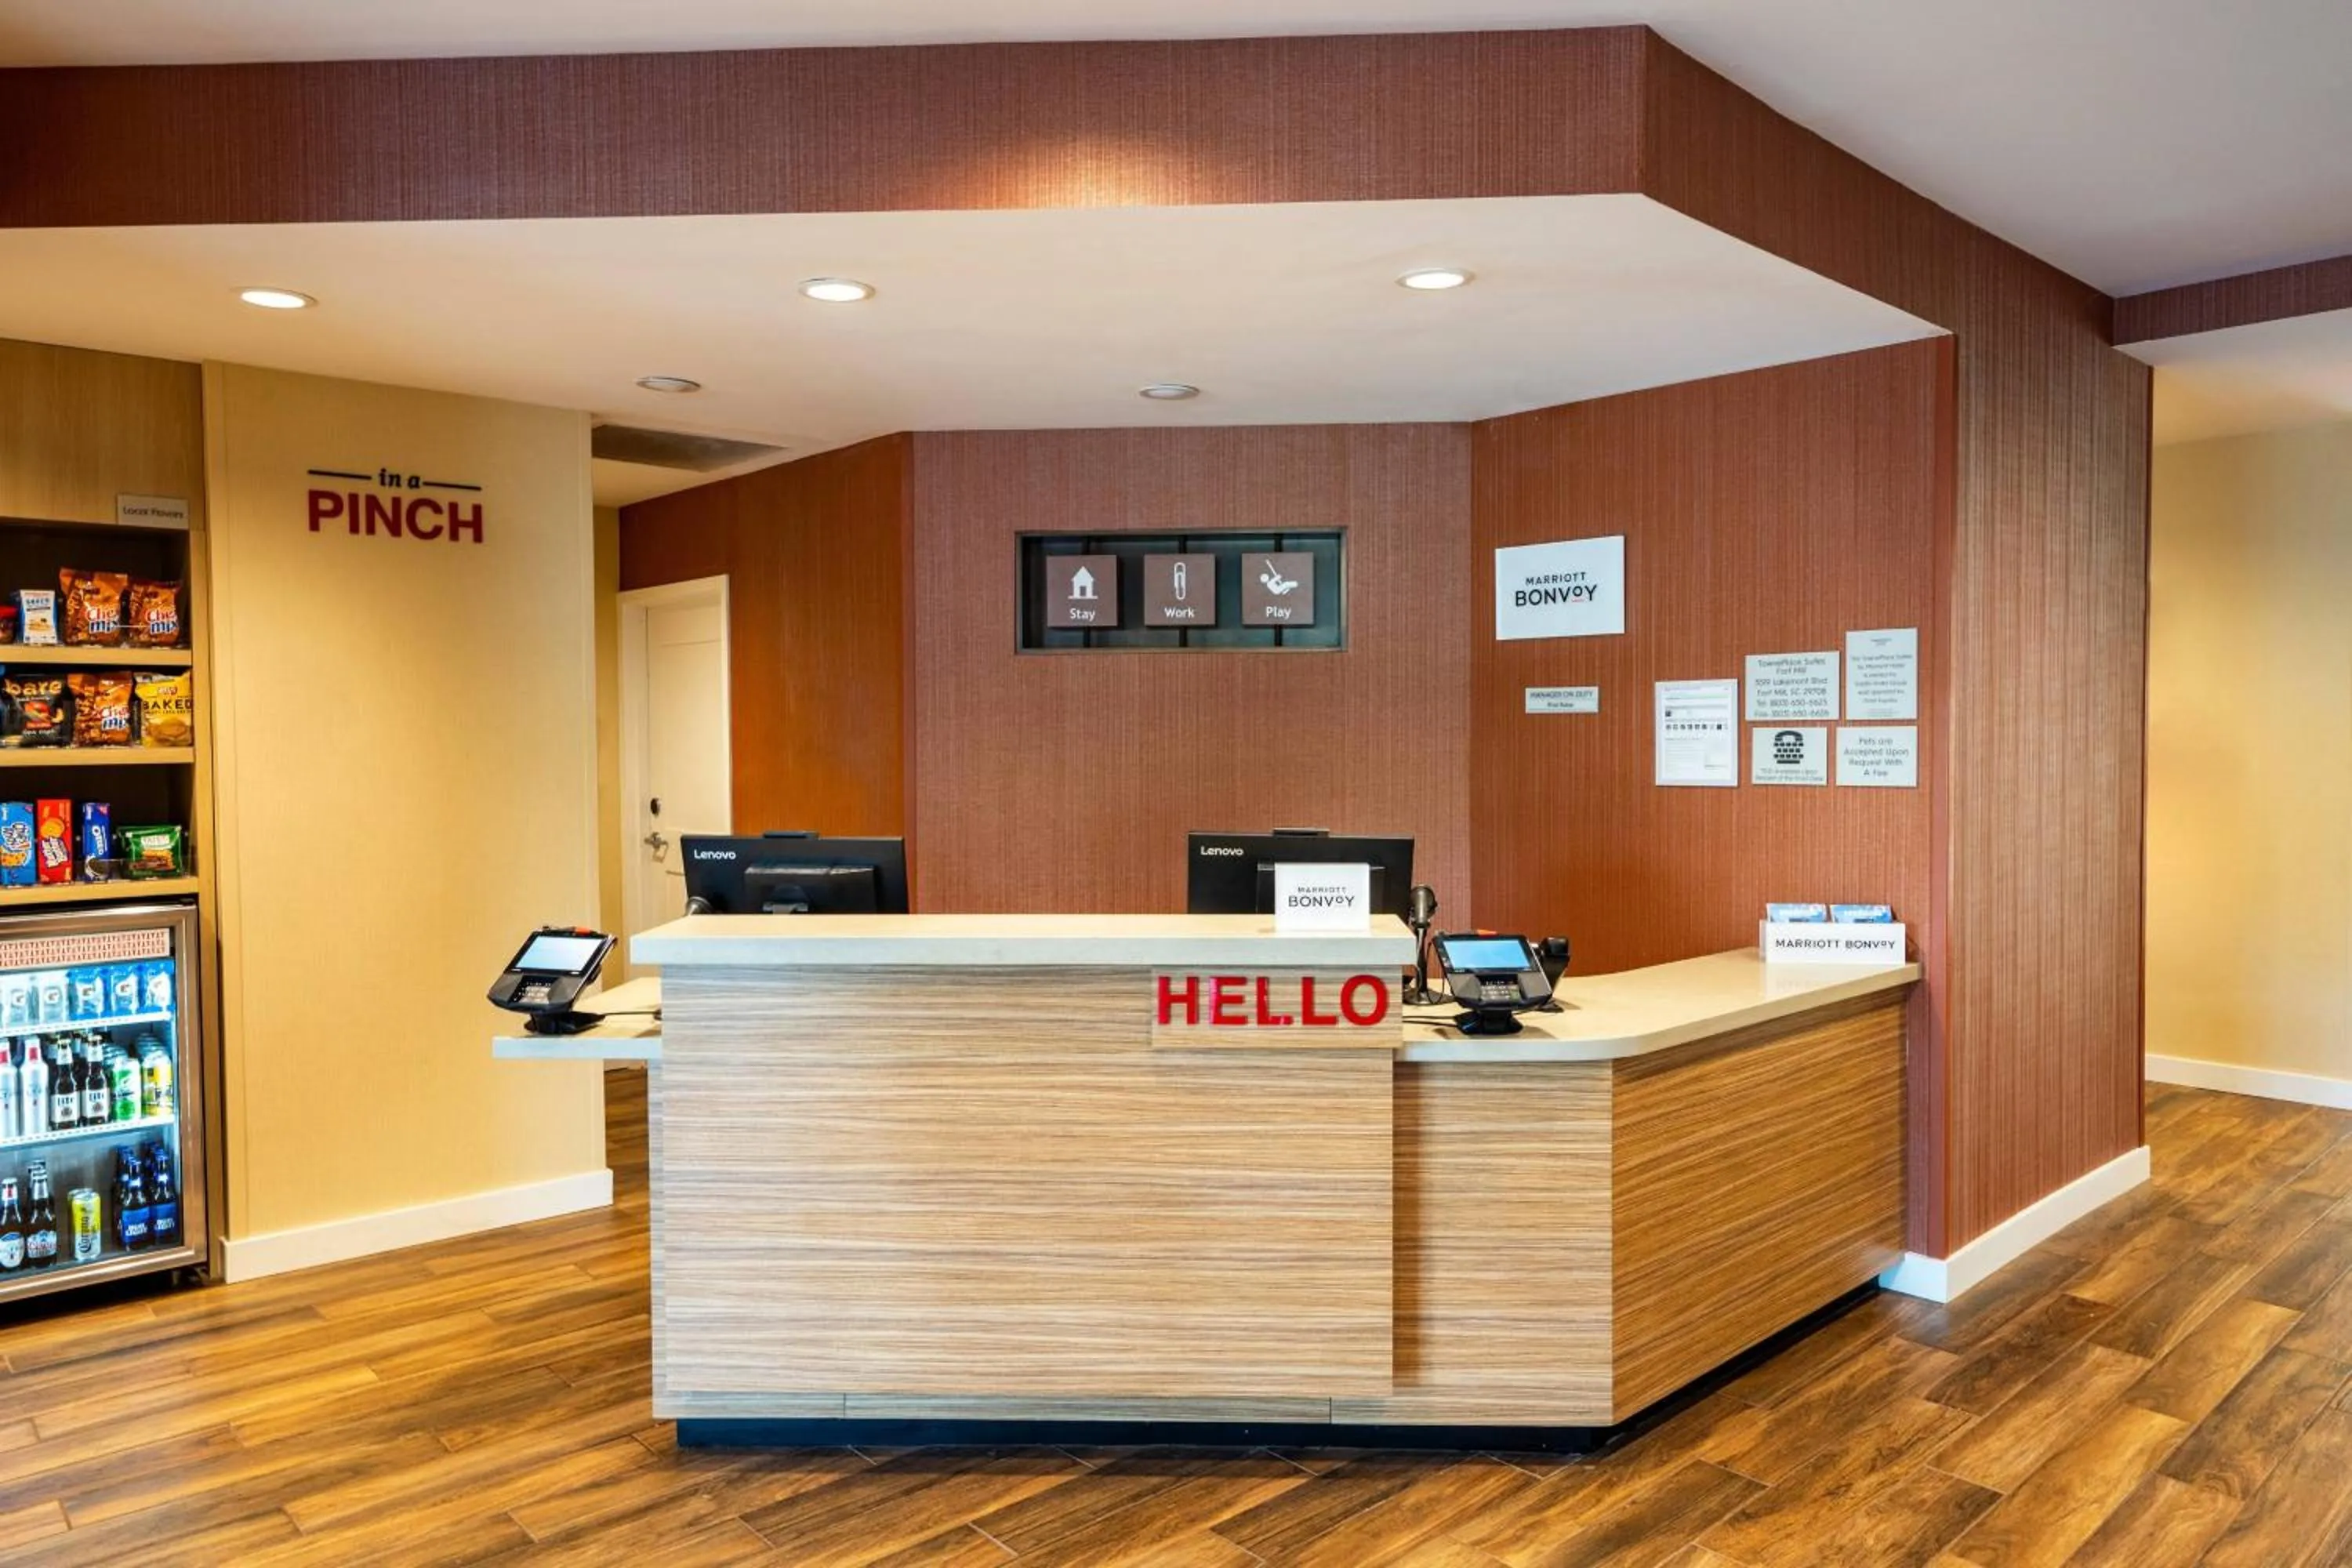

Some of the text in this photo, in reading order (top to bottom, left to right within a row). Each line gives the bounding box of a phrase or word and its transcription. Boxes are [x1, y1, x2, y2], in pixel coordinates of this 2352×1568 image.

[378, 468, 422, 489] in a
[307, 488, 484, 544] PINCH
[1525, 572, 1587, 586] MARRIOTT
[1515, 584, 1597, 607] BONVOY
[1069, 608, 1096, 621] Stay
[1164, 607, 1196, 619] Work
[1265, 606, 1292, 619] Play
[4, 678, 62, 696] bare
[143, 699, 191, 710] BAKED
[1859, 736, 1875, 746] Pets
[1843, 746, 1909, 758] Accepted Upon
[1849, 758, 1882, 767] Request
[694, 848, 736, 860] Lenovo
[1200, 846, 1243, 856] Lenovo
[1288, 895, 1355, 908] BONVOY
[1775, 938, 1839, 949] MARRIOTT
[1845, 940, 1895, 949] BONVOY
[1157, 975, 1390, 1025] HELLO
